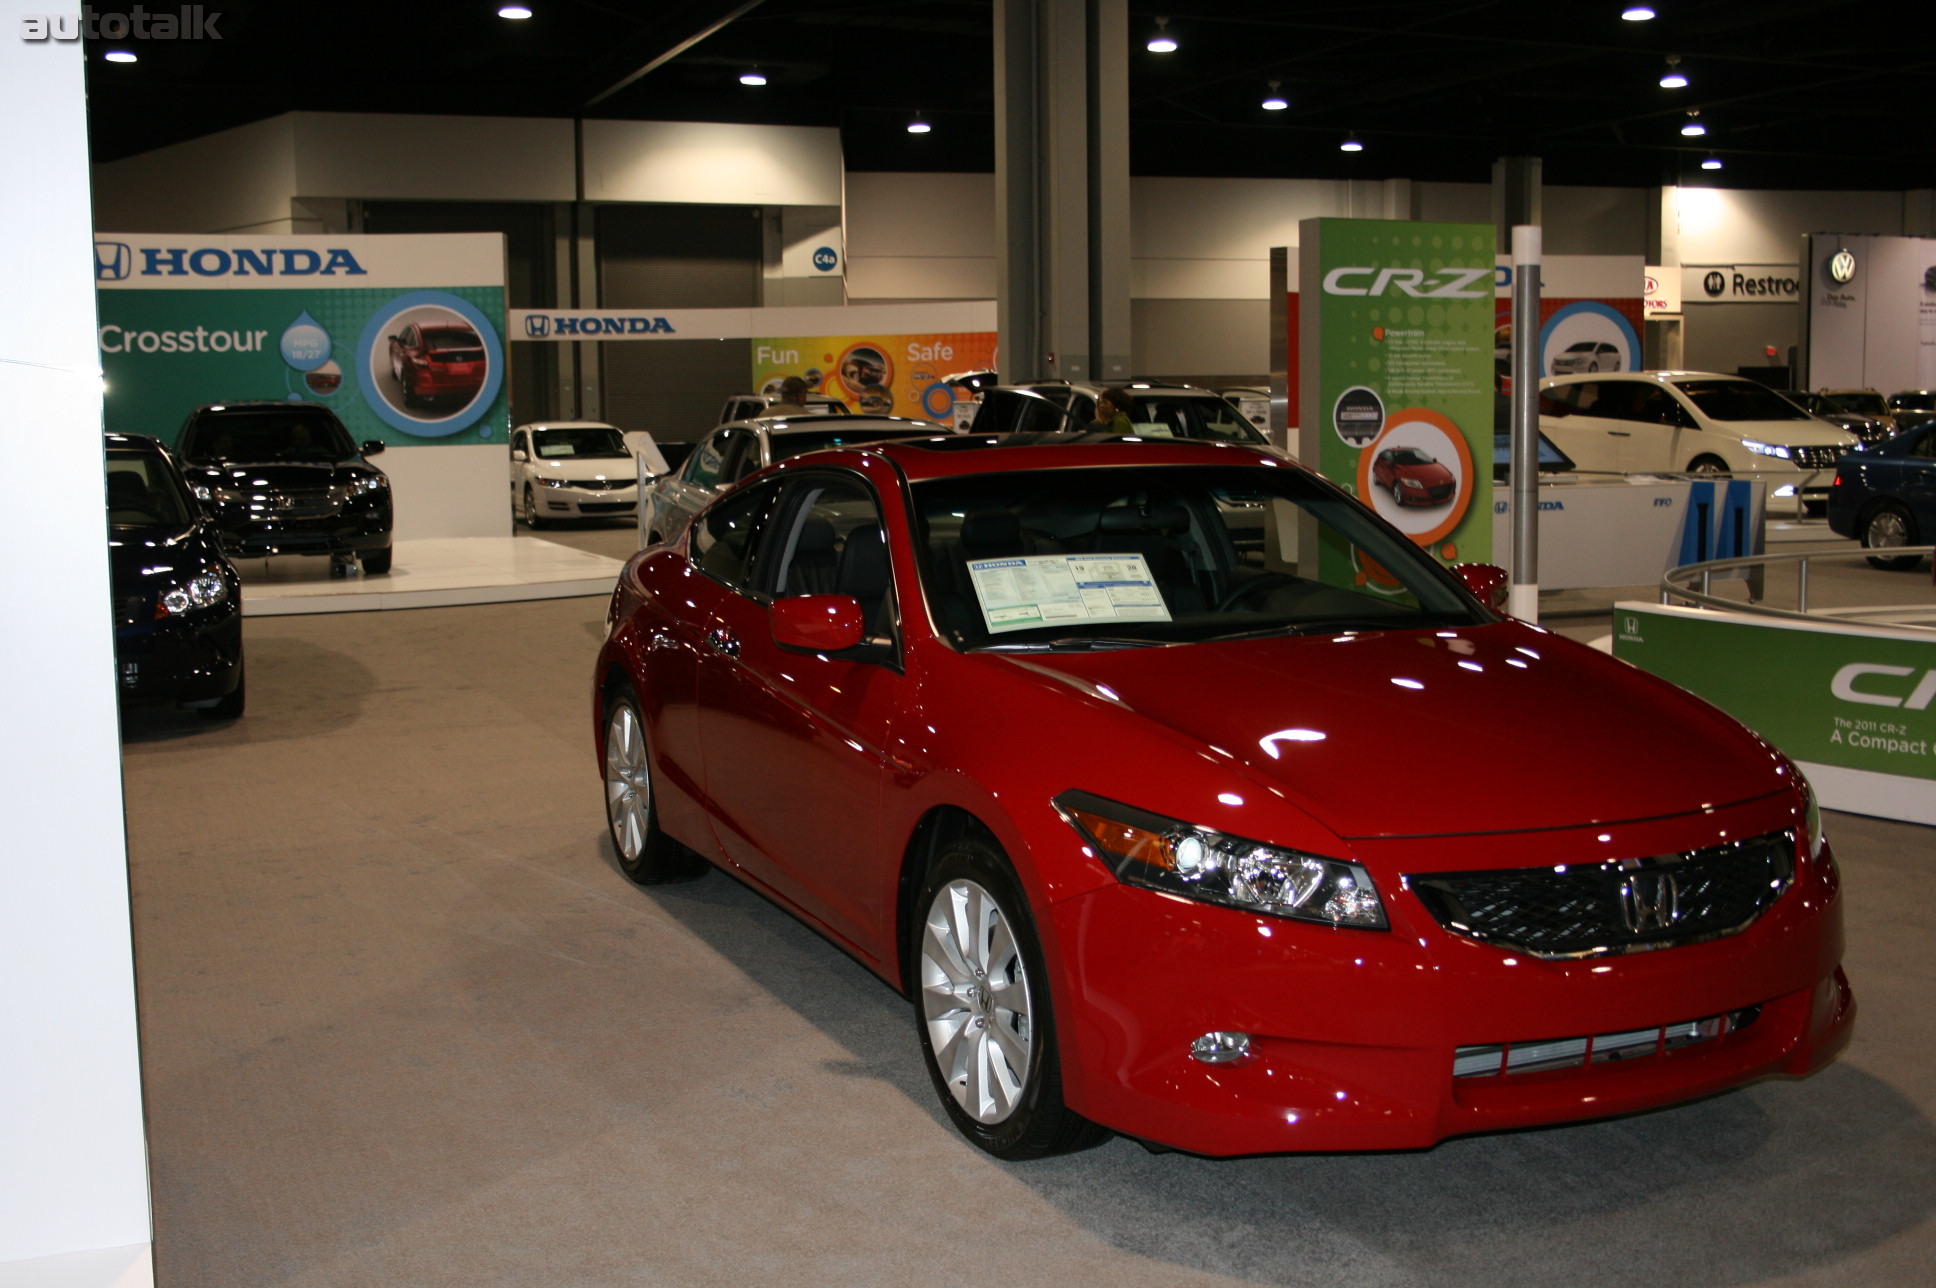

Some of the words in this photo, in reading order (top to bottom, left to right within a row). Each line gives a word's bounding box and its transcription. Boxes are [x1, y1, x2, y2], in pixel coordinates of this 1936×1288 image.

[139, 248, 368, 277] HONDA
[815, 253, 836, 265] C4a
[1322, 266, 1493, 299] CR-Z
[1732, 273, 1800, 298] Restro
[1644, 300, 1668, 309] OTORS
[554, 316, 676, 335] HONDA
[1385, 329, 1425, 337] Powertrain
[99, 324, 268, 353] Crosstour
[756, 346, 799, 365] Fun
[906, 341, 954, 362] Safe
[984, 560, 1023, 569] HONDA
[1618, 633, 1645, 643] HONDA
[1834, 717, 1853, 729] The
[1855, 720, 1877, 732] 2011
[1880, 723, 1908, 736] CR-Z
[1830, 728, 1843, 745] A
[1848, 731, 1928, 756] Compact
